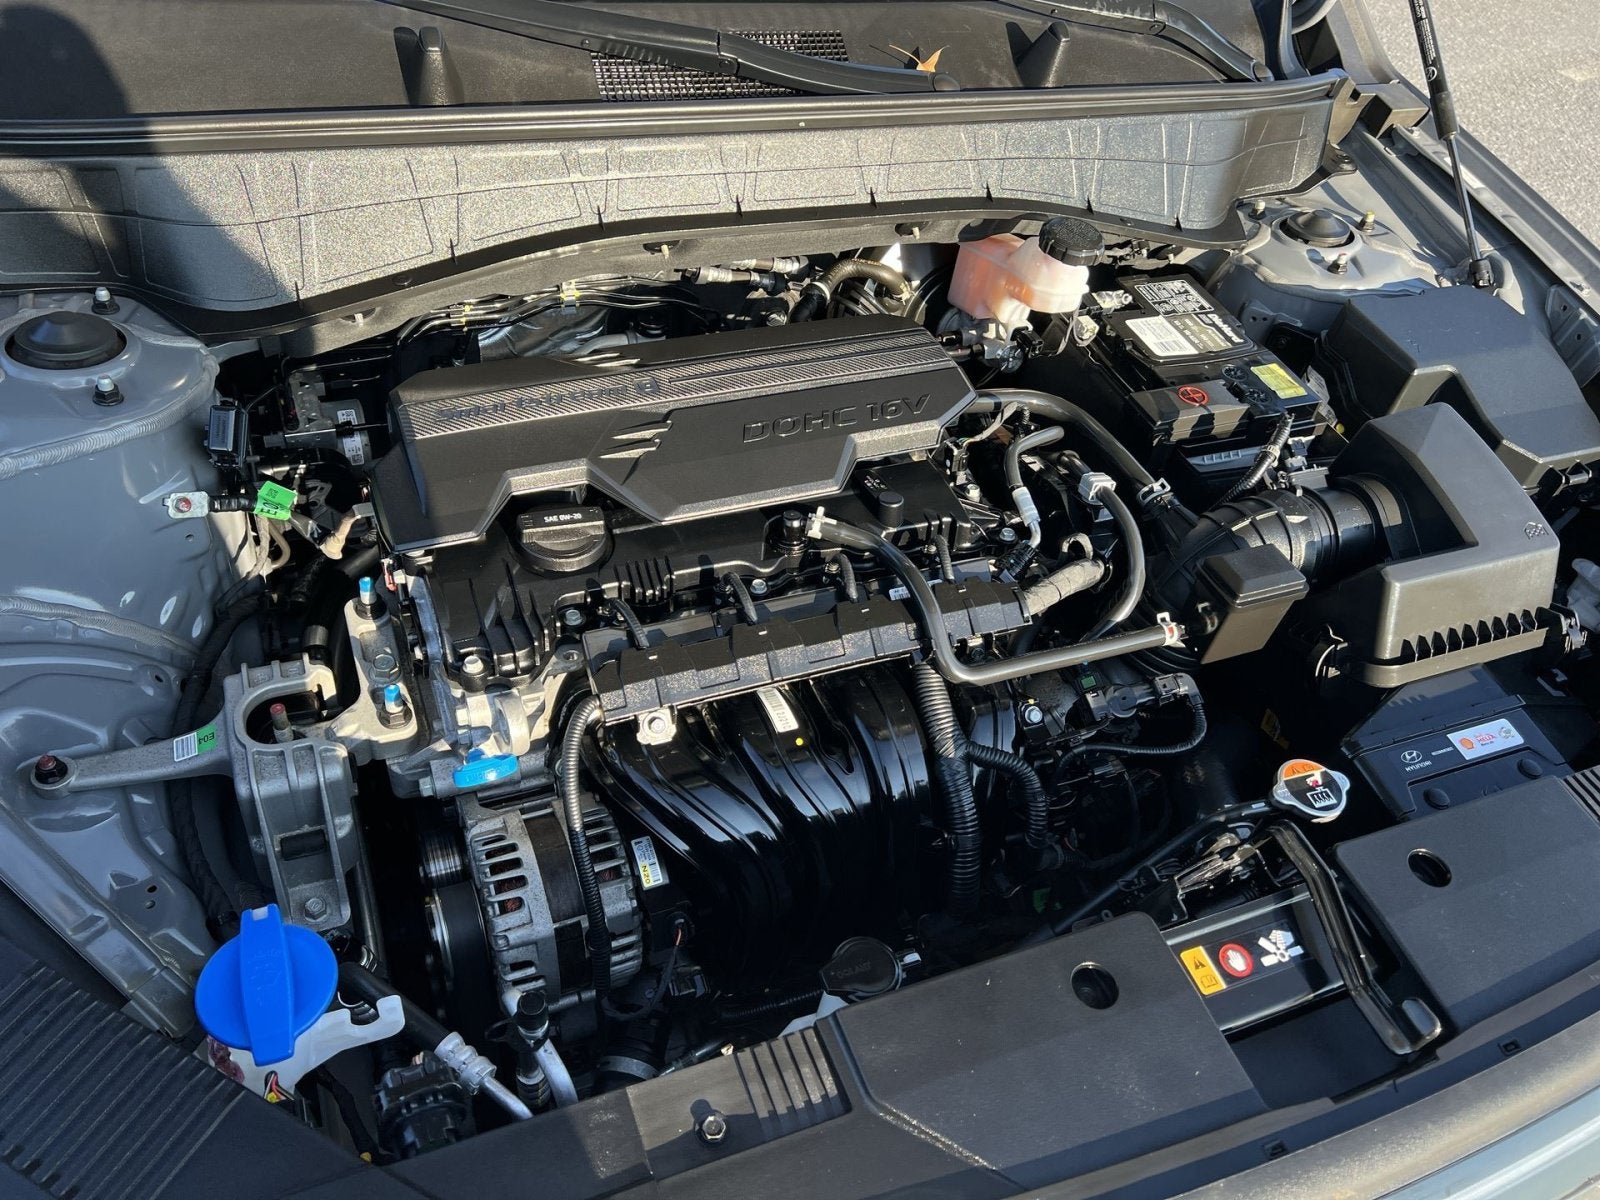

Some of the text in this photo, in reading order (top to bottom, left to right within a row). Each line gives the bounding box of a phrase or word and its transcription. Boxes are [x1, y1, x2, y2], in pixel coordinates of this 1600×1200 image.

[743, 394, 931, 443] DOHC 16V
[543, 512, 583, 523] SAE 0W-20
[198, 731, 215, 745] E04
[1405, 760, 1432, 772] HYUNDAI
